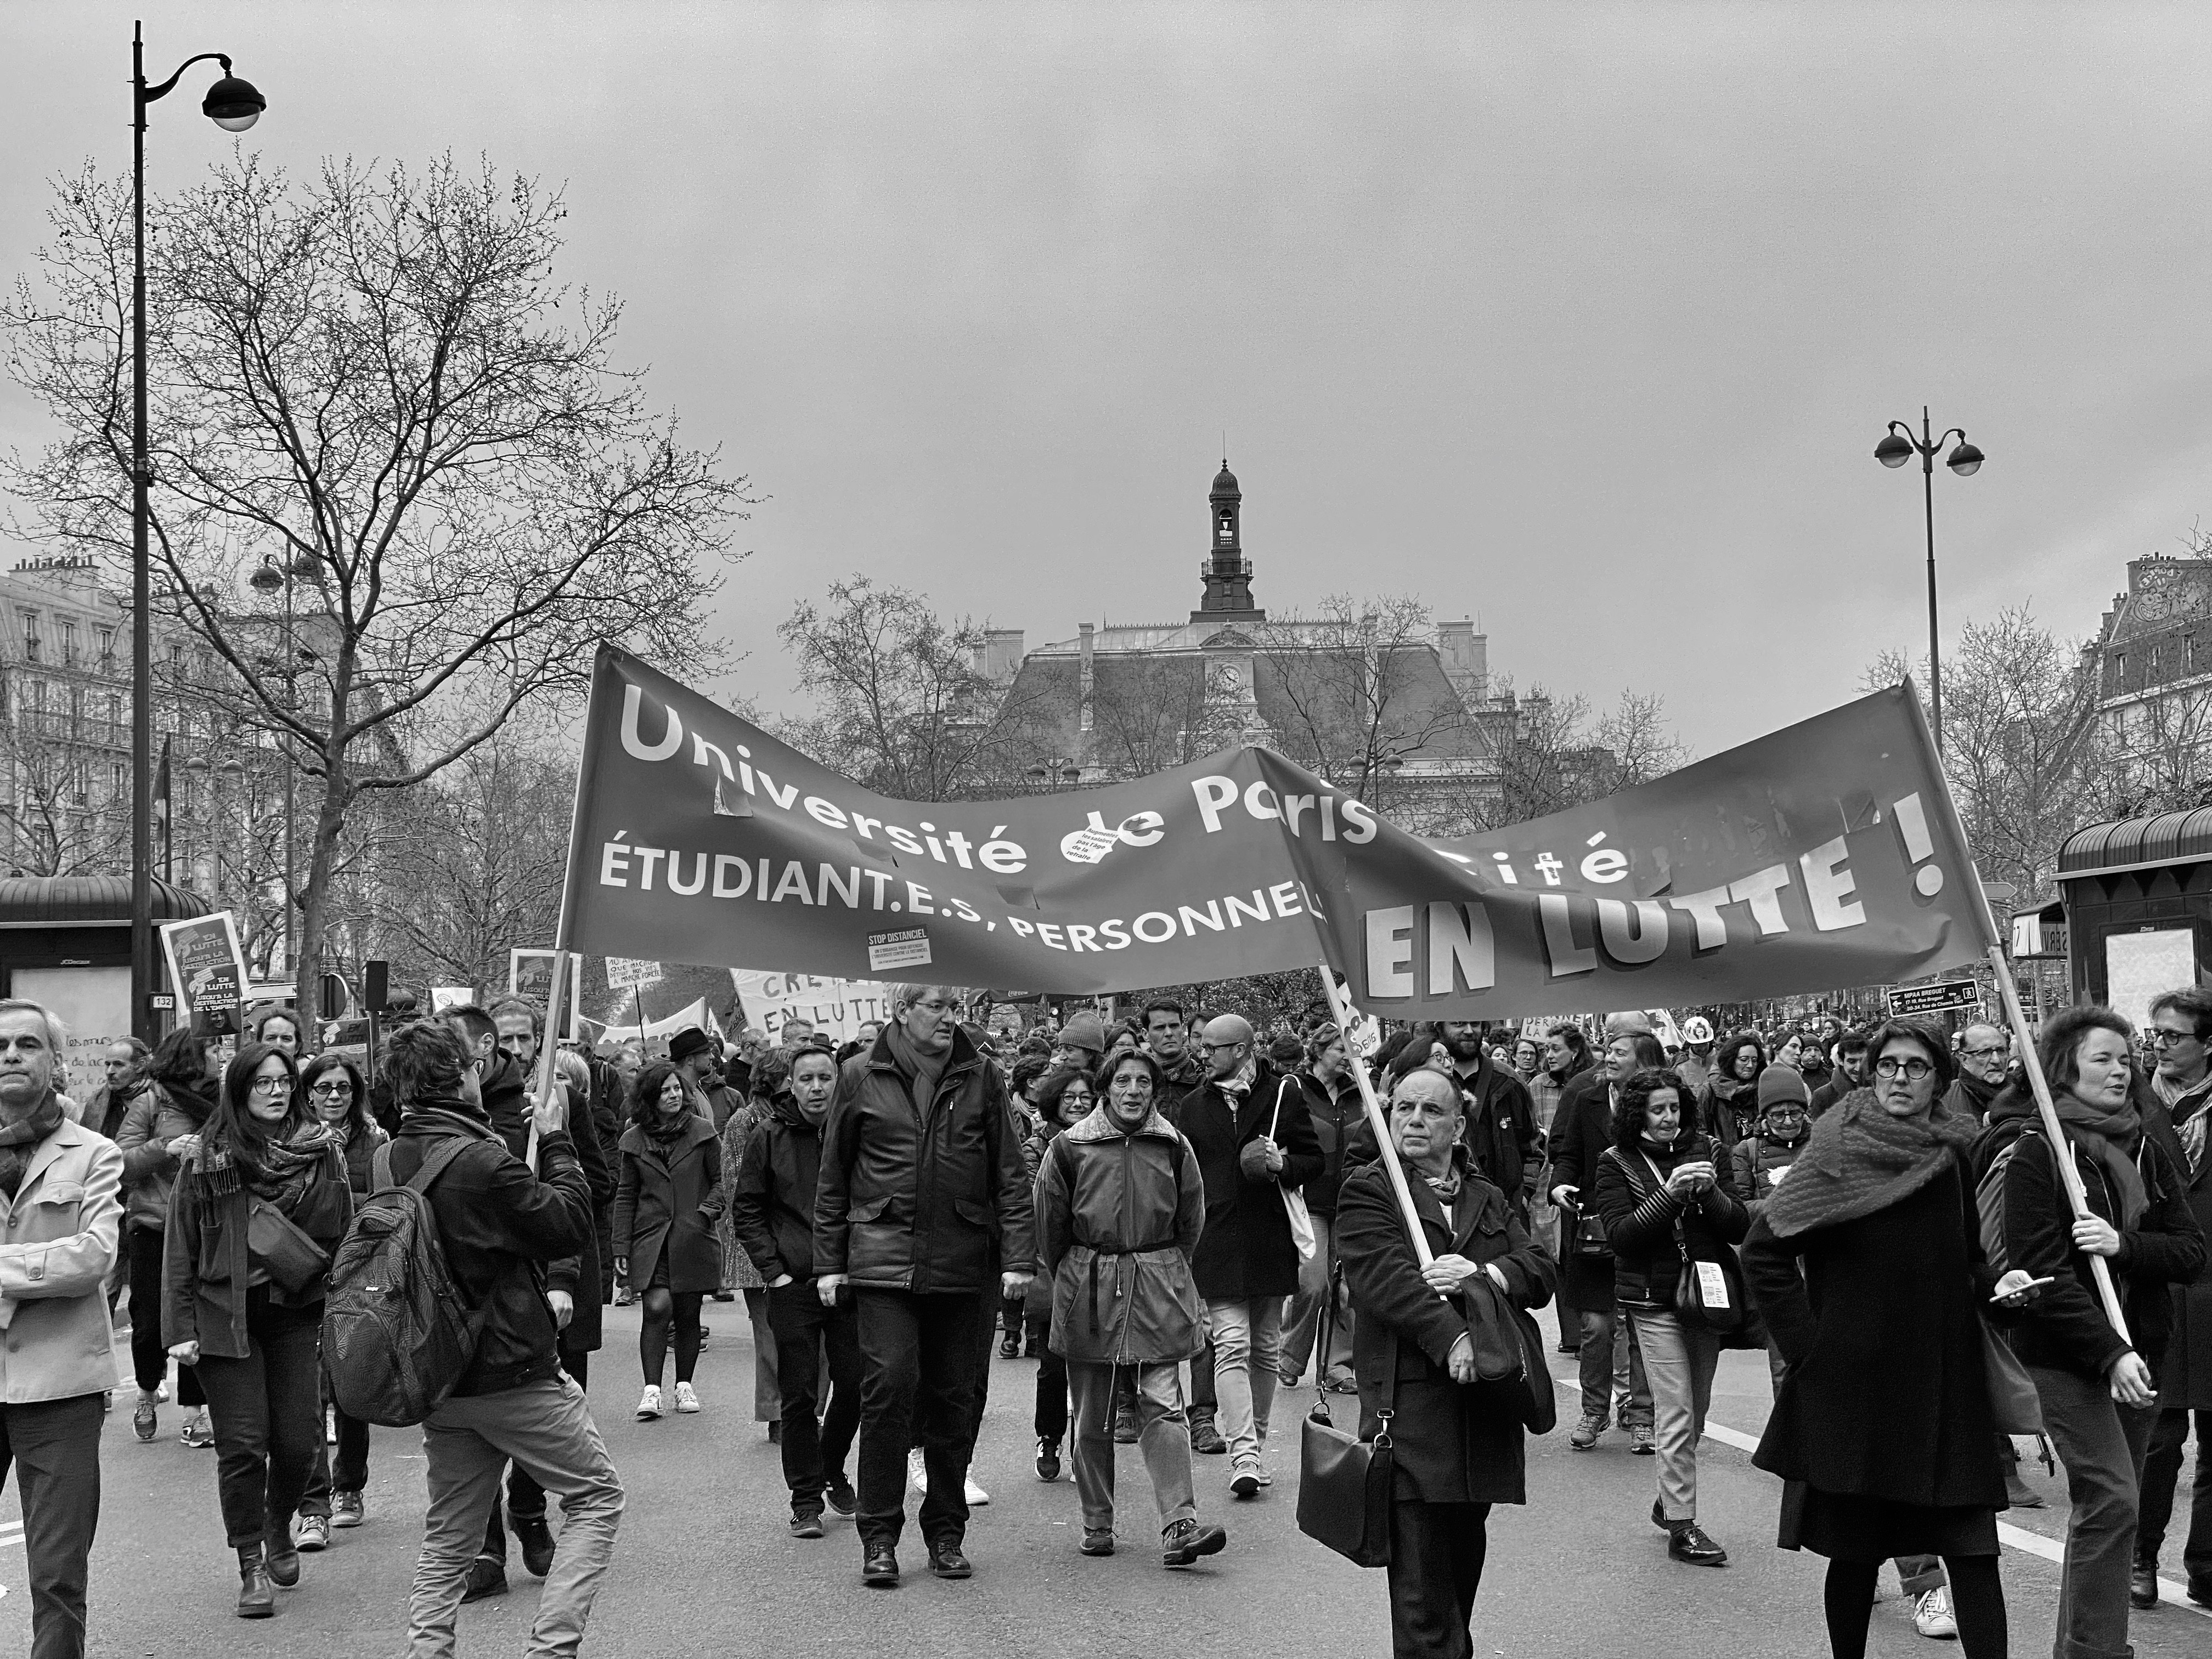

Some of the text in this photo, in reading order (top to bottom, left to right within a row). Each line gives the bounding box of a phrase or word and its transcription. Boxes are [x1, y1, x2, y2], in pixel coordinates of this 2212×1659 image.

[620, 684, 1629, 885] Université de Paris ité
[1087, 828, 1118, 838] Augmentez
[1090, 842, 1105, 850] l'âge
[1066, 850, 1091, 860] retraite
[1007, 880, 1328, 953] PERSONNEL
[1366, 900, 1495, 997] EN
[1538, 834, 1867, 978] LUTTE
[1893, 791, 1944, 896] !
[868, 928, 927, 945] STOP DISTANCIEL
[191, 939, 225, 951] LUTTE
[609, 957, 619, 966] 10
[621, 974, 641, 983] MARCHE
[206, 982, 235, 991] LUTTE
[1921, 988, 1946, 996] BREGUET
[193, 998, 238, 1007] DESTRUCTION
[764, 1006, 798, 1033] EN
[813, 998, 891, 1024] LUTTE
[1526, 1025, 1541, 1037] LA
